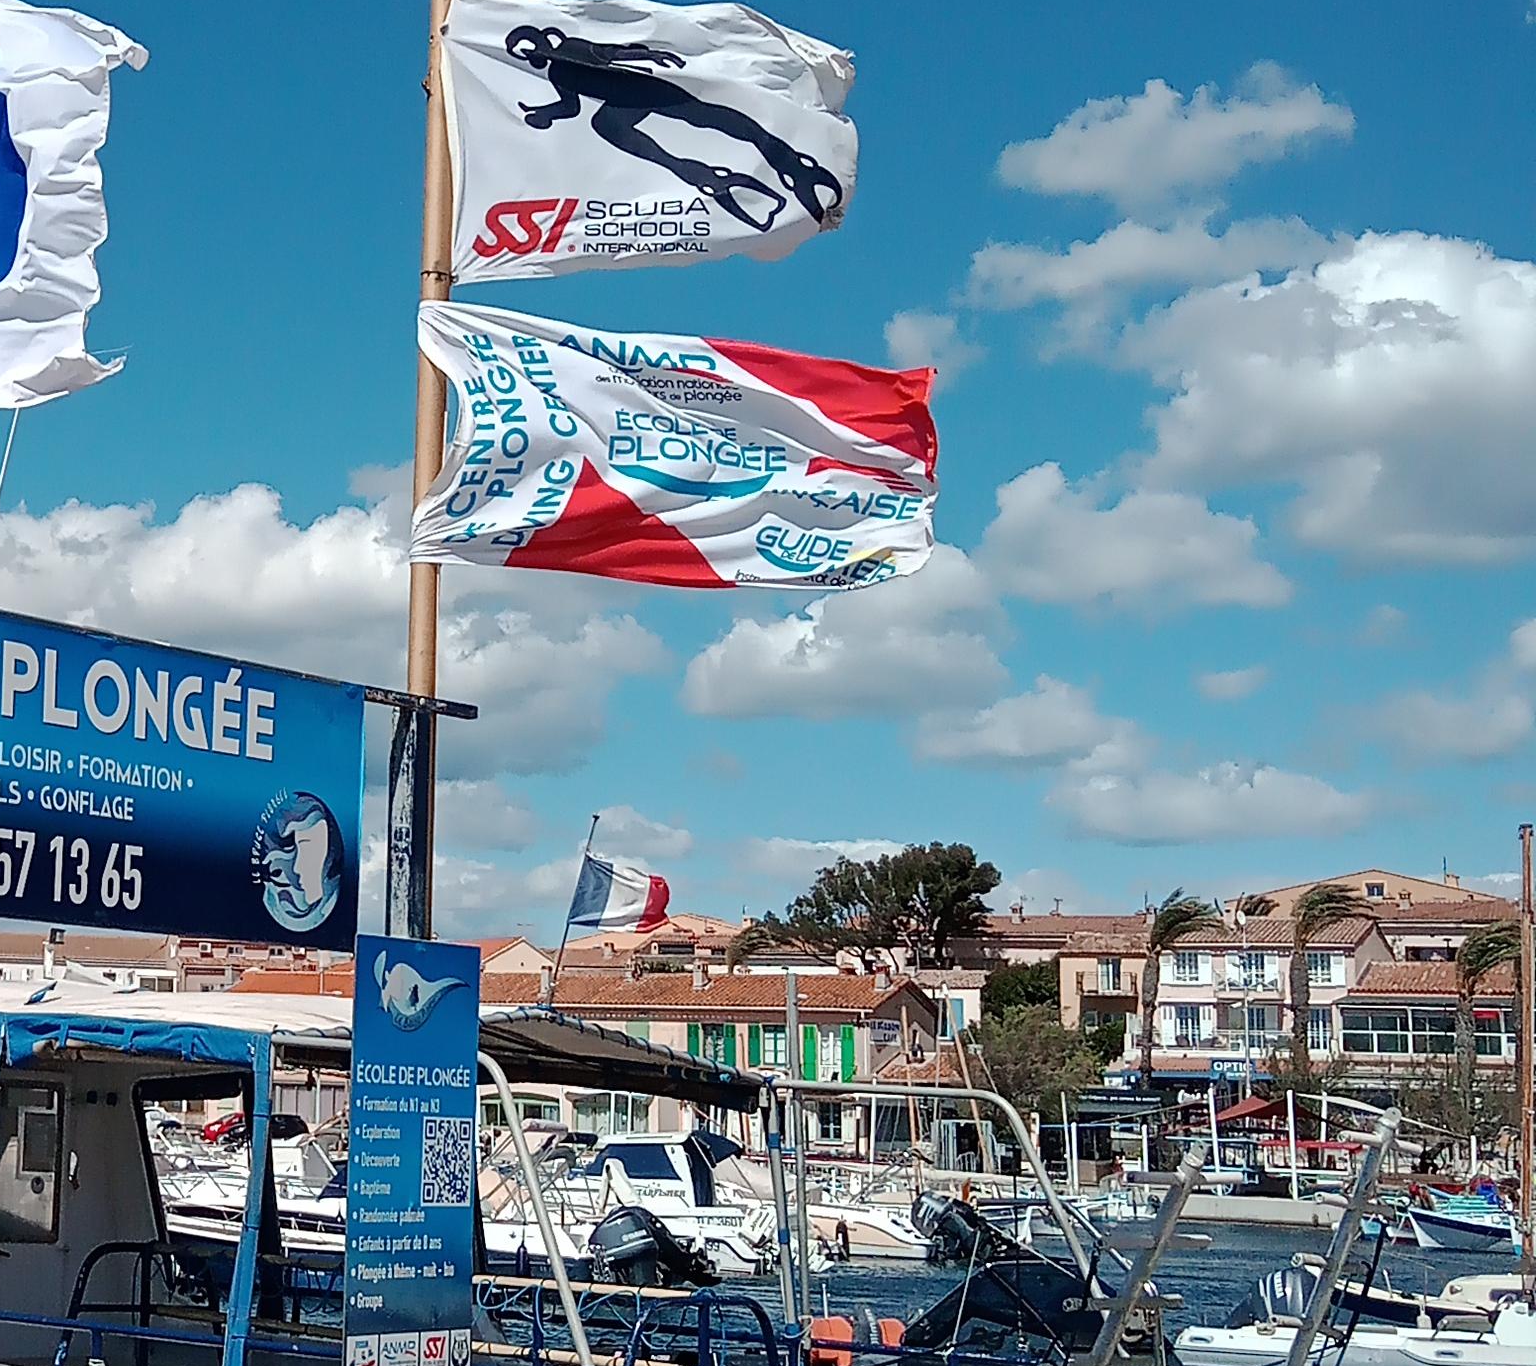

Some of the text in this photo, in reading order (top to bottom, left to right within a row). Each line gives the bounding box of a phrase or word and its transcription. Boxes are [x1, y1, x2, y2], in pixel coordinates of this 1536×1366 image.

[585, 196, 711, 220] SCUBA
[472, 197, 580, 258] SSI
[584, 221, 711, 237] SCHOOLS
[582, 241, 709, 253] INTERNATIONAL
[684, 390, 743, 404] plongée
[445, 375, 496, 519] CENTRE
[608, 434, 787, 472] PLONGÉE
[756, 525, 853, 562] GUIDE
[0, 639, 276, 762] PLONGÉE
[79, 755, 183, 792] FORMATION
[40, 785, 134, 821] GONFLAGE
[49, 835, 90, 905] 13
[100, 843, 144, 910] 65
[356, 1059, 471, 1088] ÉCOLE DE PLONGÉE
[363, 1095, 398, 1112] Formation
[399, 1097, 409, 1113] du
[362, 1123, 401, 1143] Exploration
[358, 1235, 385, 1252] Enfants
[412, 1235, 422, 1251] de
[357, 1262, 387, 1284] Plongée
[356, 1292, 384, 1312] Groupe
[423, 1336, 446, 1359] SSI
